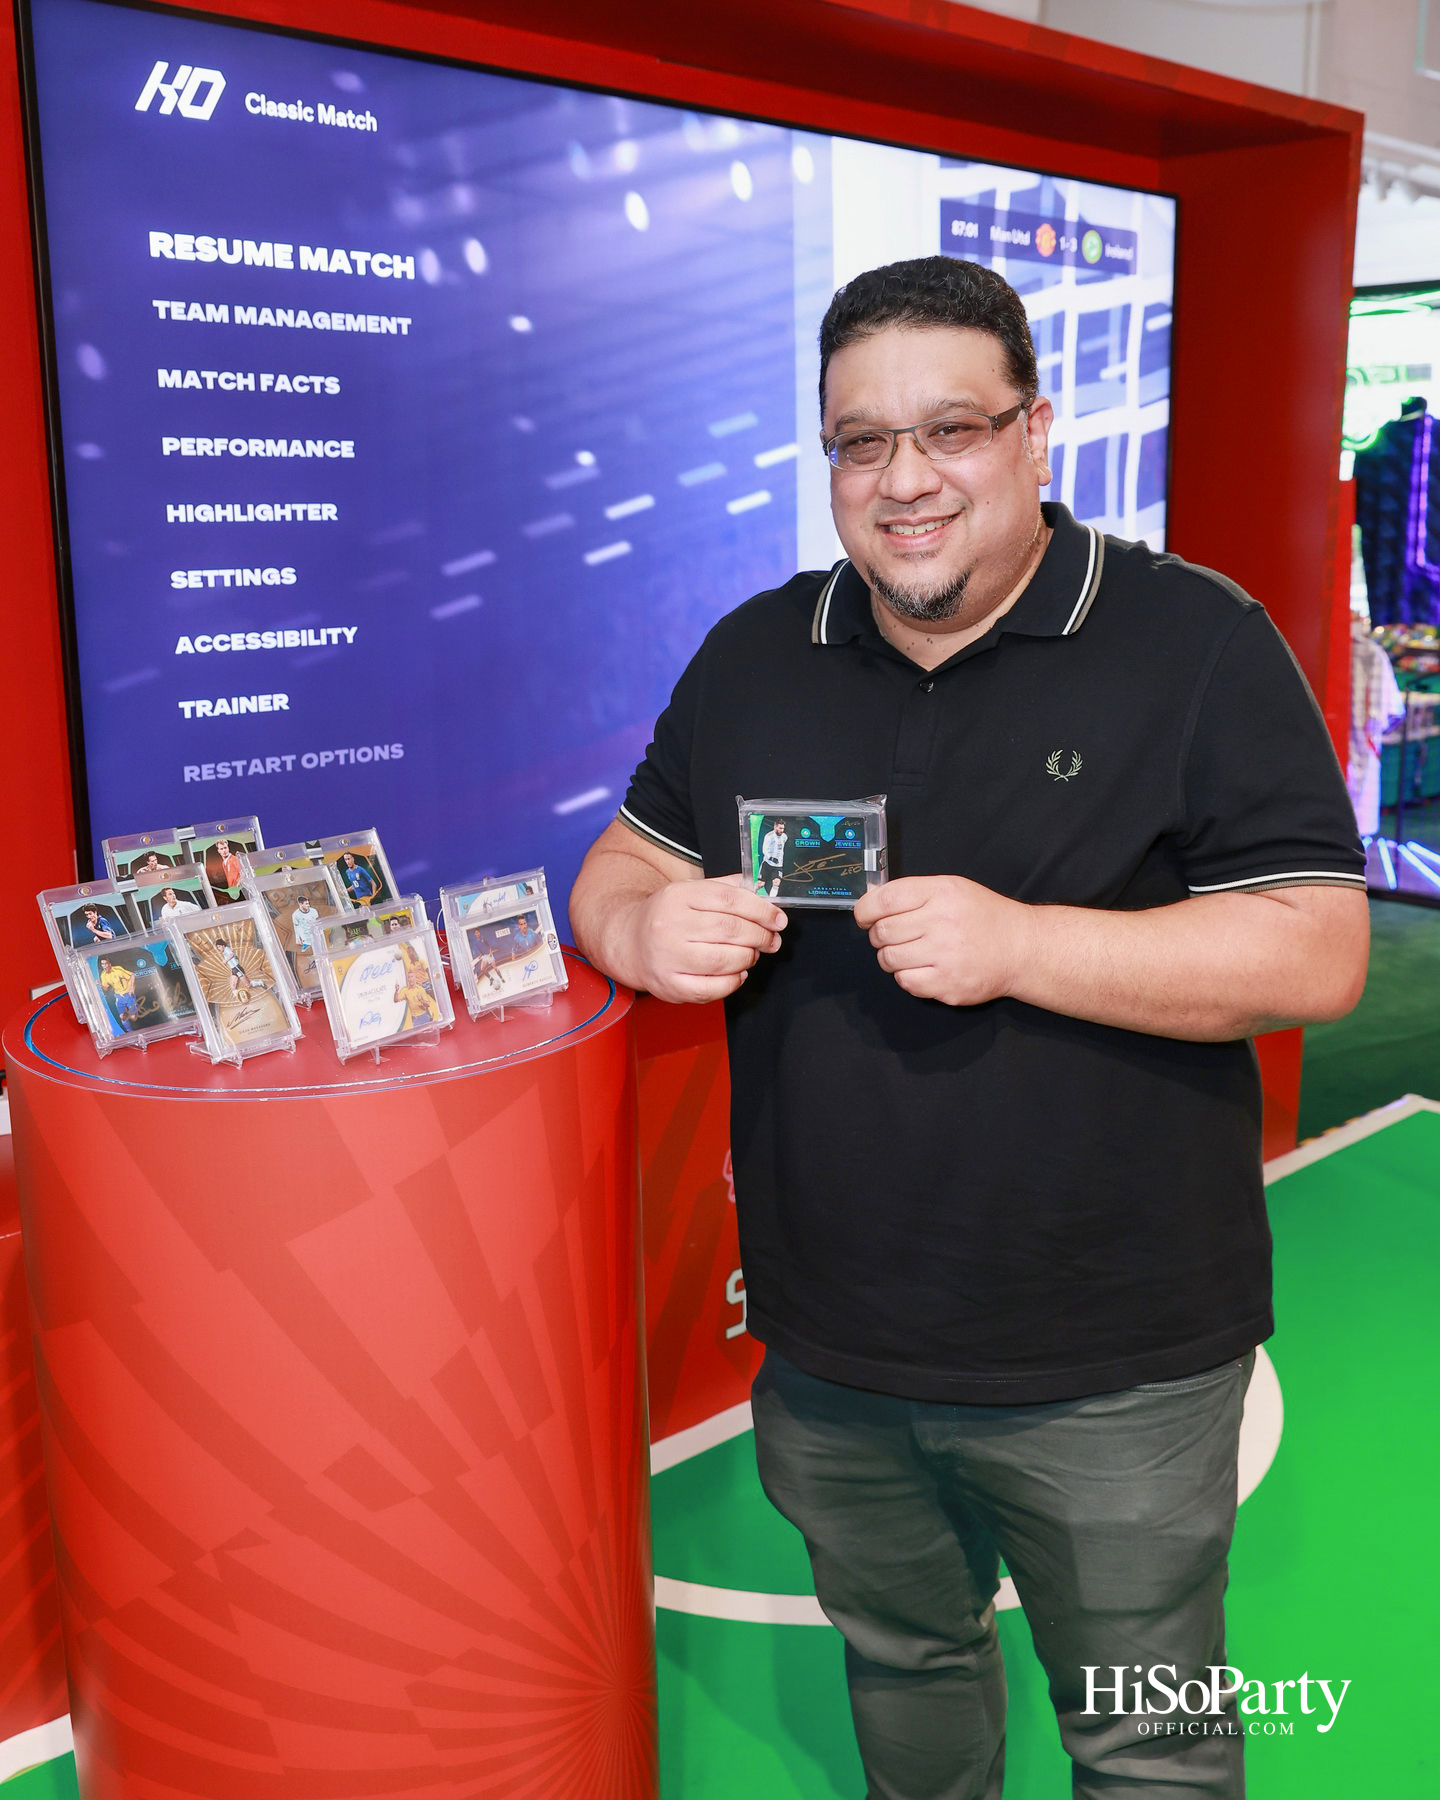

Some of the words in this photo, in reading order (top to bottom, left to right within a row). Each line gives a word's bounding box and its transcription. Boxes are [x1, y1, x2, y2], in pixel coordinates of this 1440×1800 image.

[245, 92, 315, 123] Classic
[317, 103, 378, 132] Match
[990, 225, 1012, 243] Man
[149, 231, 294, 269] RESUME
[299, 246, 415, 280] MATCH
[152, 299, 229, 324] TEAM
[234, 305, 412, 335] MANAGEMENT
[157, 368, 255, 391] MATCH
[260, 373, 341, 394] FACTS
[162, 437, 355, 458] PERFORMANCE
[166, 503, 338, 522] HIGHLIGHTER
[170, 567, 297, 589] SETTINGS
[175, 626, 358, 654] ACCESSIBILITY
[178, 693, 290, 718] TRAINER
[183, 754, 296, 783] RESTART
[301, 743, 405, 770] OPTIONS
